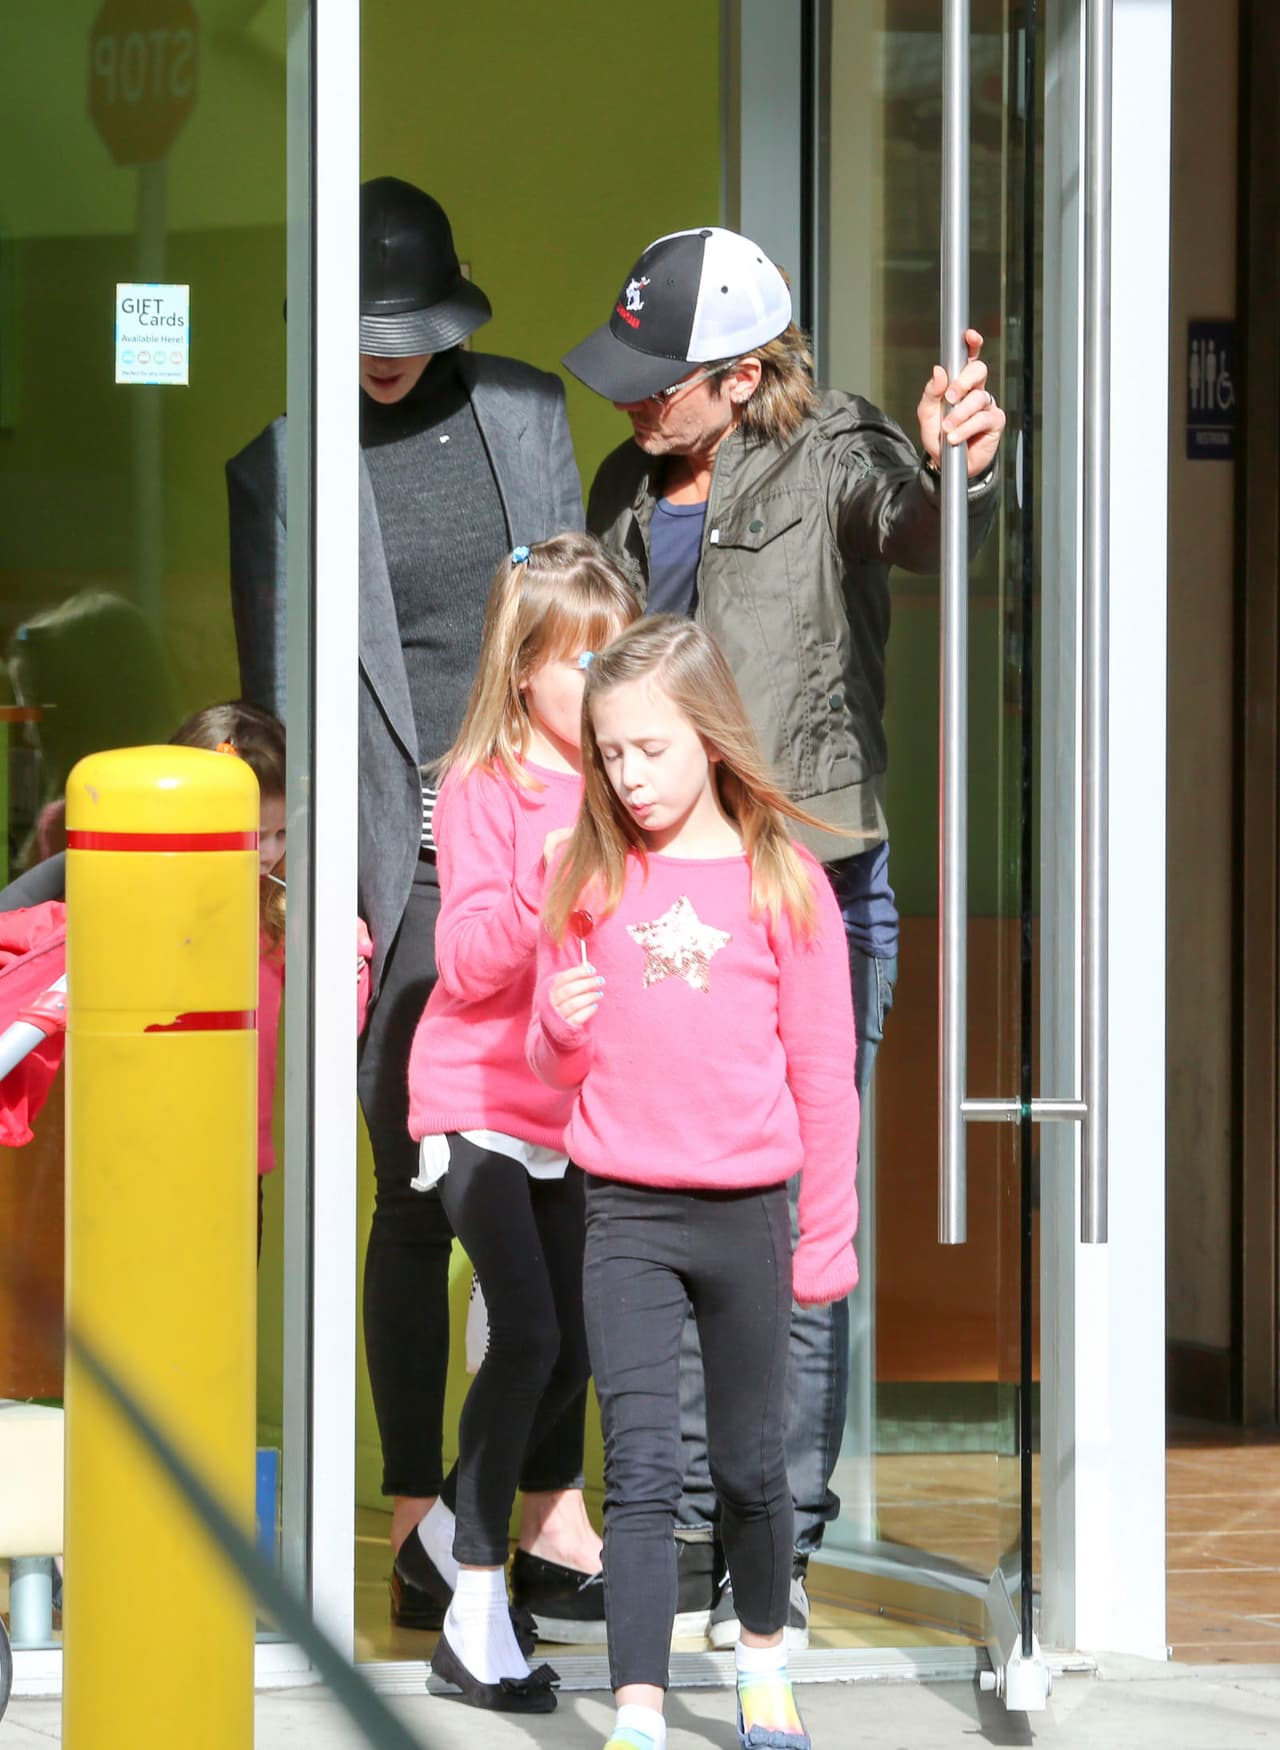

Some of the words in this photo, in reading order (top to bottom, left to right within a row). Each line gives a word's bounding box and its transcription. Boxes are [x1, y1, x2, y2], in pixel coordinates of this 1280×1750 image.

[121, 298, 164, 314] GIFT
[139, 312, 184, 327] Cards
[121, 335, 159, 344] Available
[160, 336, 184, 344] Here!
